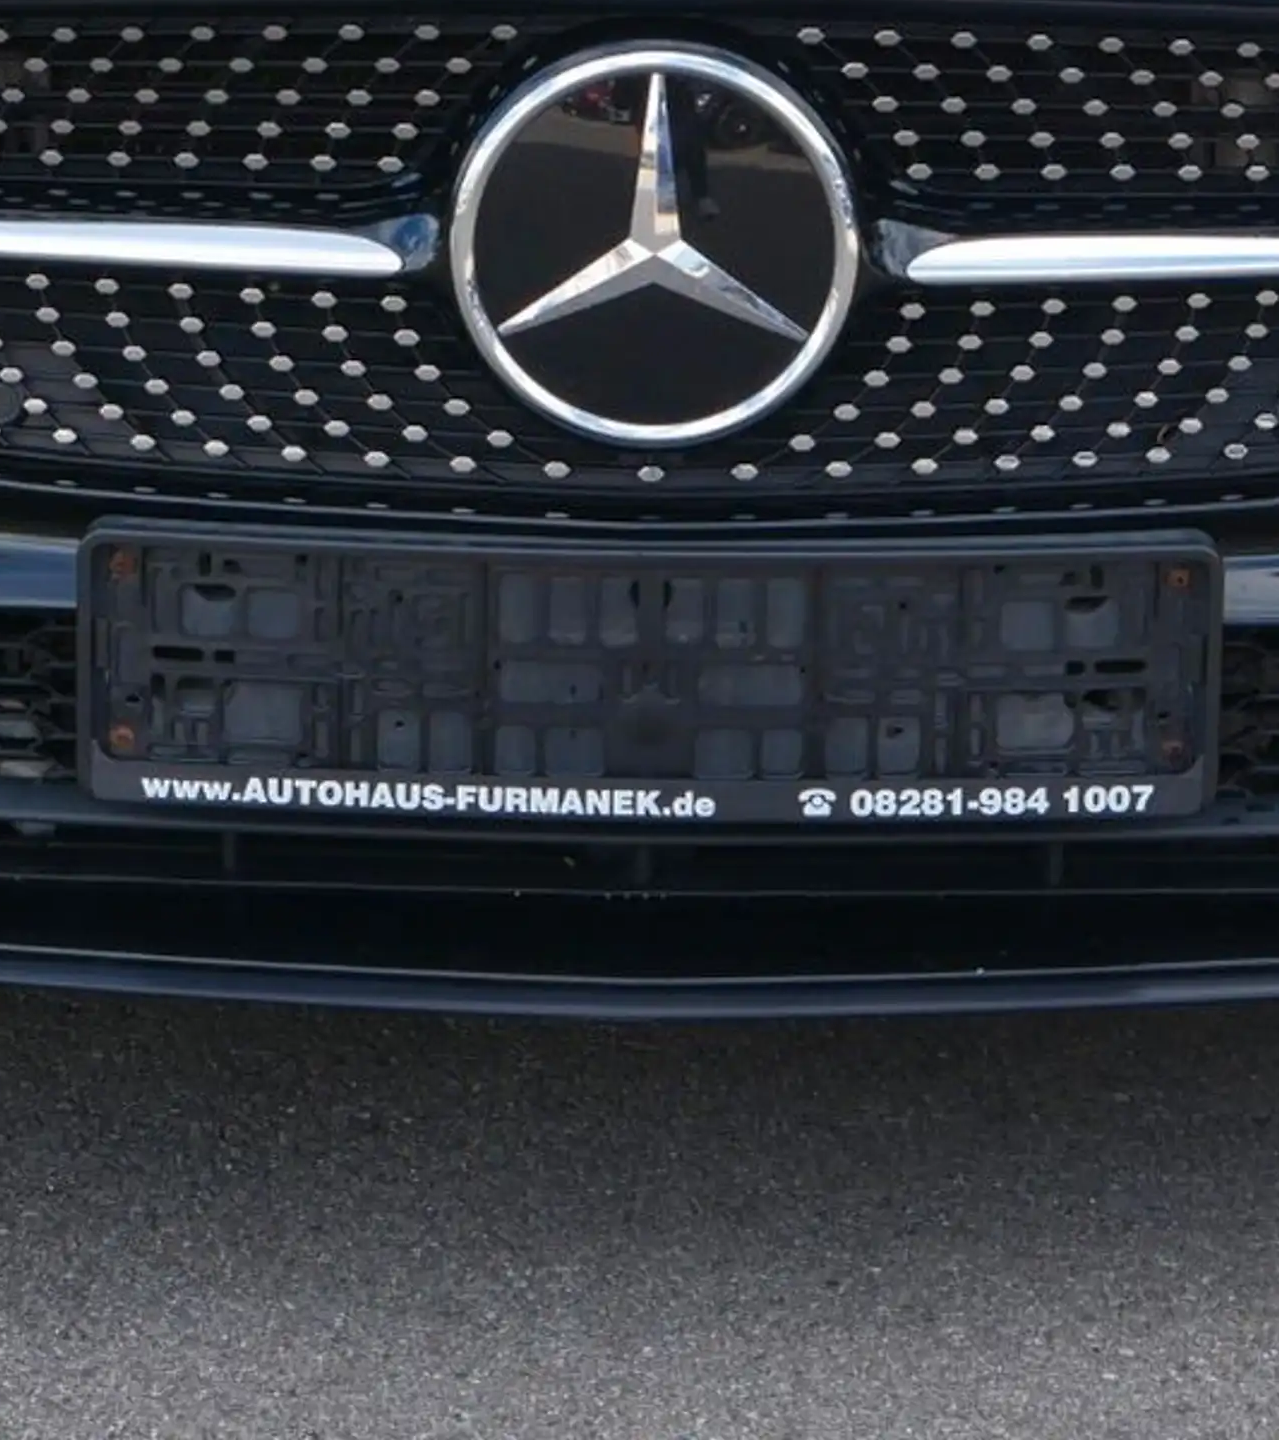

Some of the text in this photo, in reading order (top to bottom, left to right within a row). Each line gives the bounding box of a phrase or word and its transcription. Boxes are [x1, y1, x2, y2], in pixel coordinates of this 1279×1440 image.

[140, 775, 1155, 818] www.AUTOHAUS-FURMANEK.de 08281-984 1007
